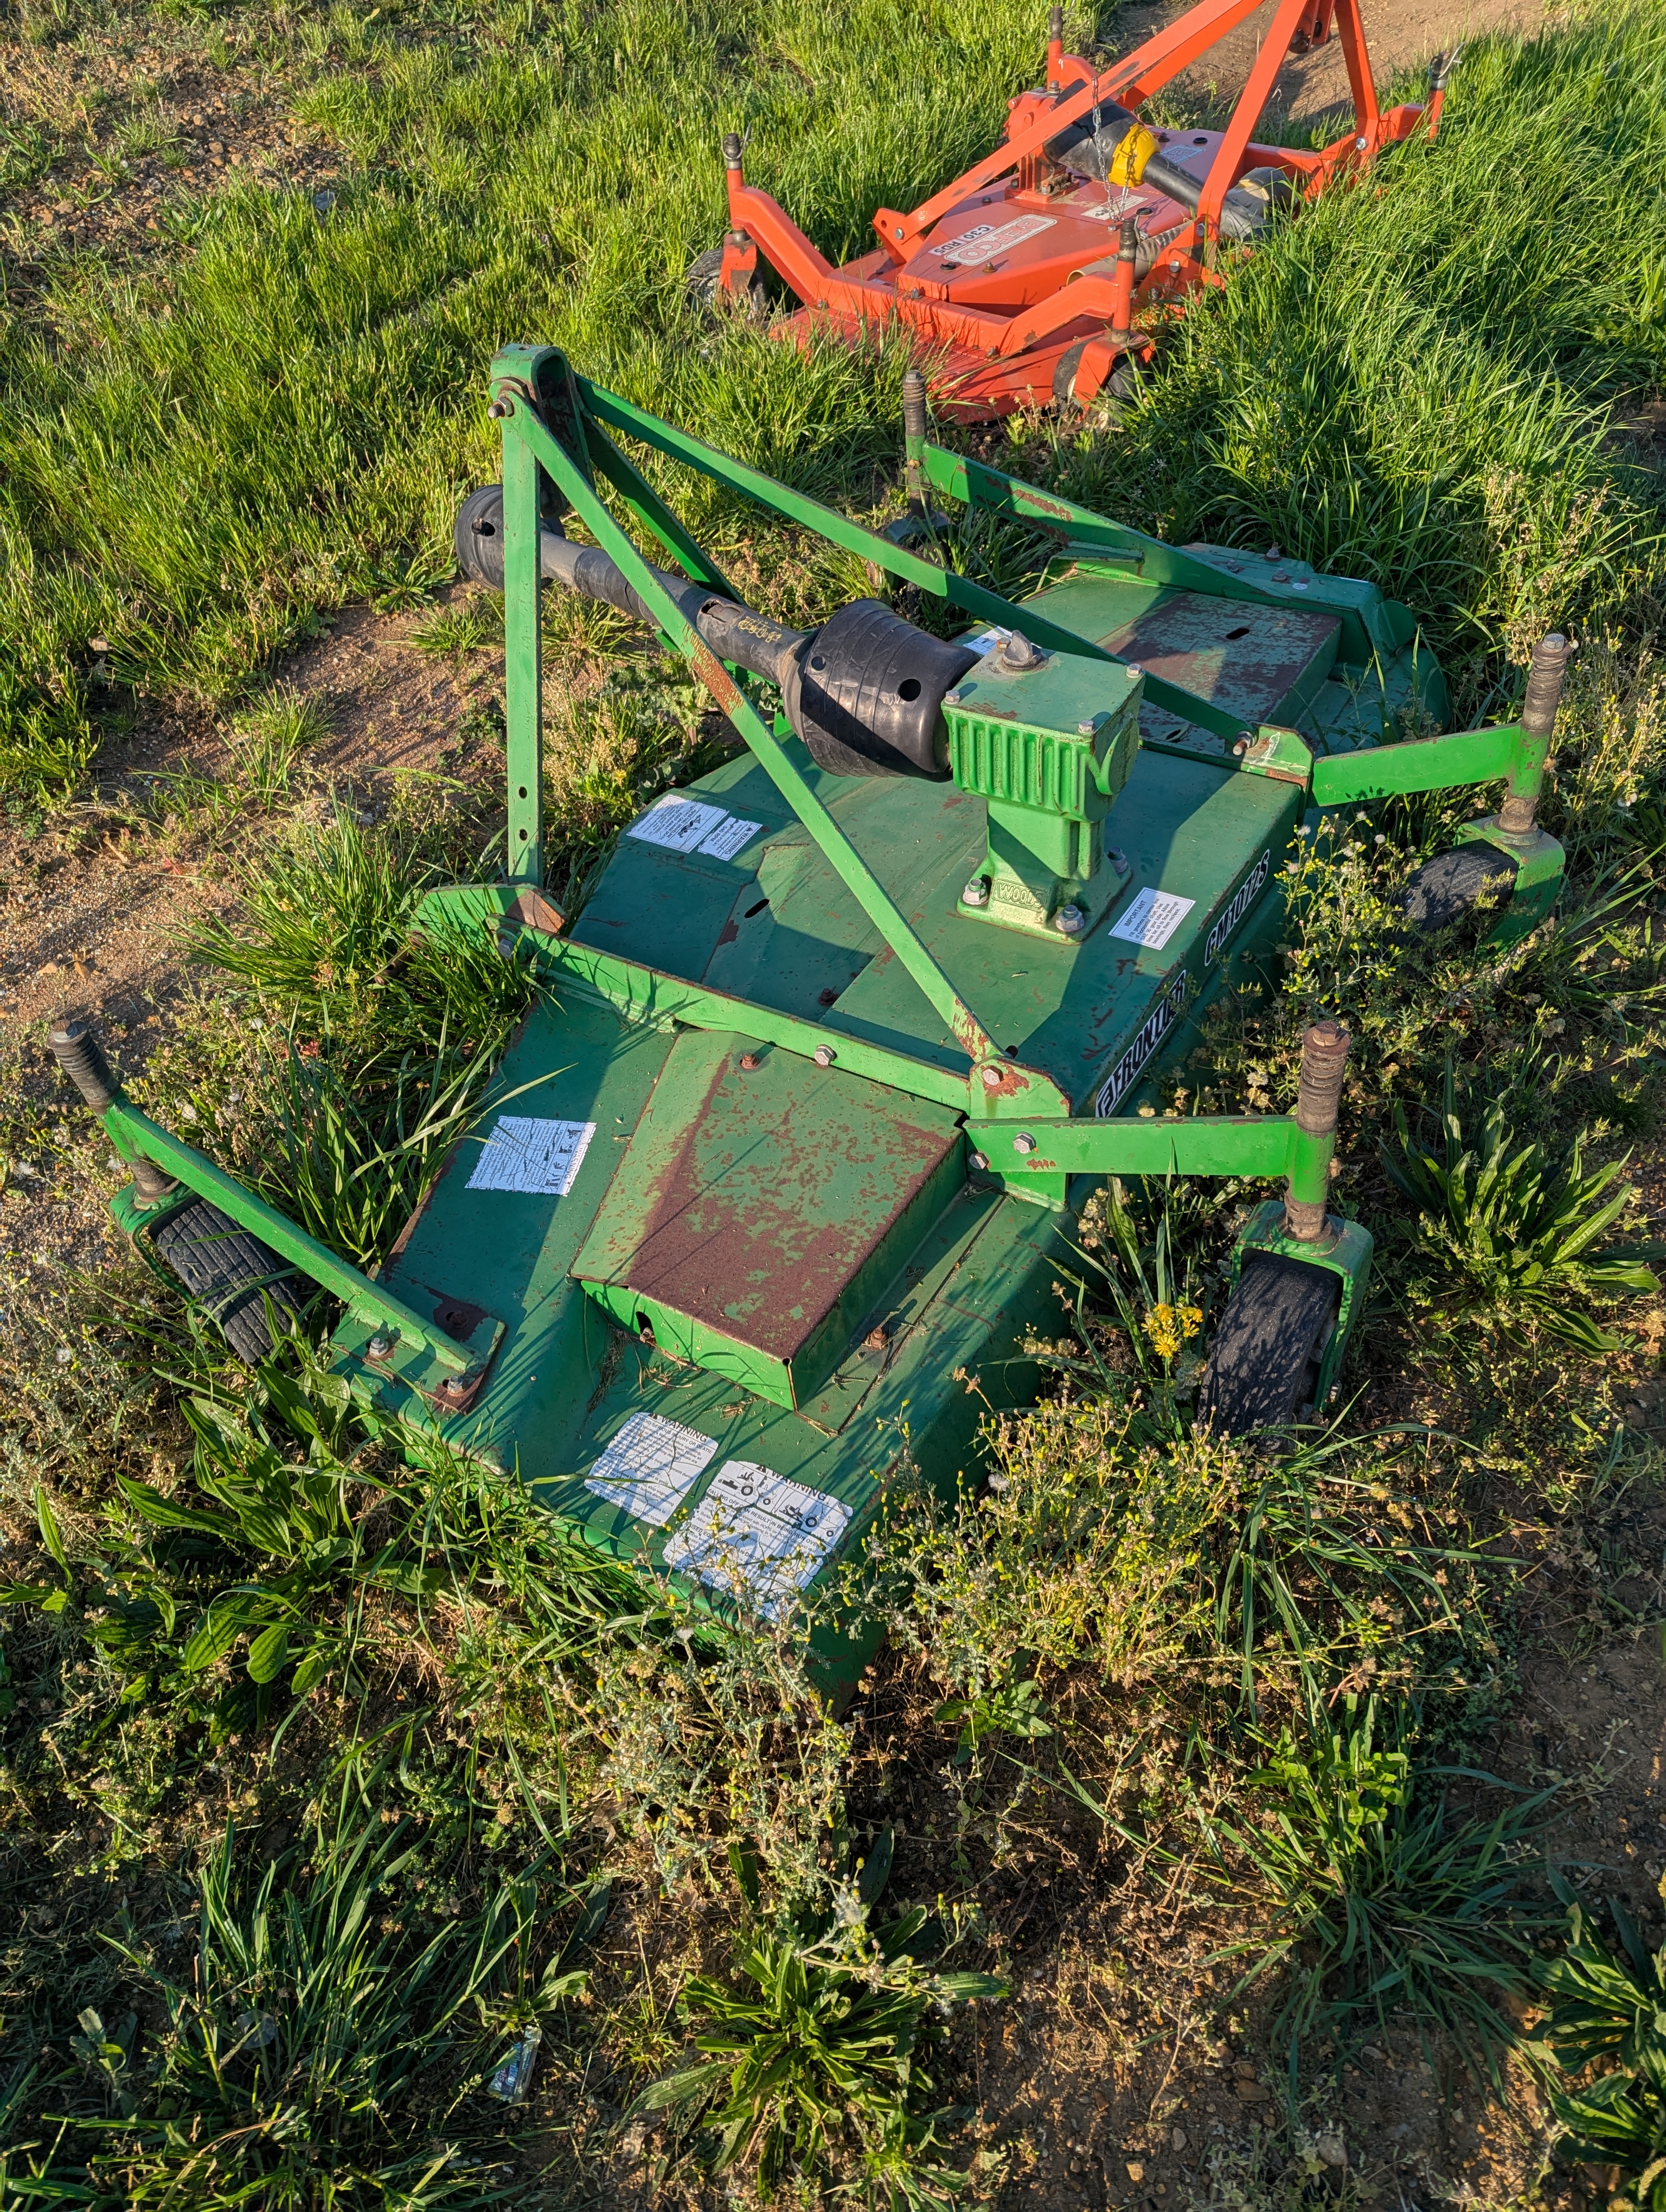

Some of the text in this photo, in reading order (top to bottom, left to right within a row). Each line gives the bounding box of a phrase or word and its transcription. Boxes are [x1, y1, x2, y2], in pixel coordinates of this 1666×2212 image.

[933, 226, 991, 255] C30 RD5
[958, 218, 1047, 261] BEFCO
[723, 832, 749, 855] WARNING
[997, 882, 1044, 909] WOODS
[1167, 901, 1180, 914] through
[1123, 900, 1148, 927] IMPORTANT
[1132, 918, 1146, 932] gearbox
[1145, 904, 1156, 914] center
[1137, 918, 1152, 935] horizontal
[1149, 921, 1158, 929] gear
[637, 1416, 652, 1425] AVOID
[651, 1423, 672, 1435] SERIOUS
[671, 1432, 689, 1443] INJURY
[695, 1444, 713, 1454] DEATH:
[659, 1416, 709, 1442] WARNING
[658, 1432, 672, 1441] Manual
[683, 1445, 702, 1456] operating,
[655, 1489, 670, 1499] engine,
[770, 1470, 828, 1501] WARNING
[602, 1491, 620, 1502] FOLLOW
[619, 1500, 633, 1509] THESE
[728, 1499, 739, 1507] OFF
[749, 1510, 770, 1523] RESULT
[776, 1523, 793, 1535] BEING
[793, 1532, 806, 1541] RUN
